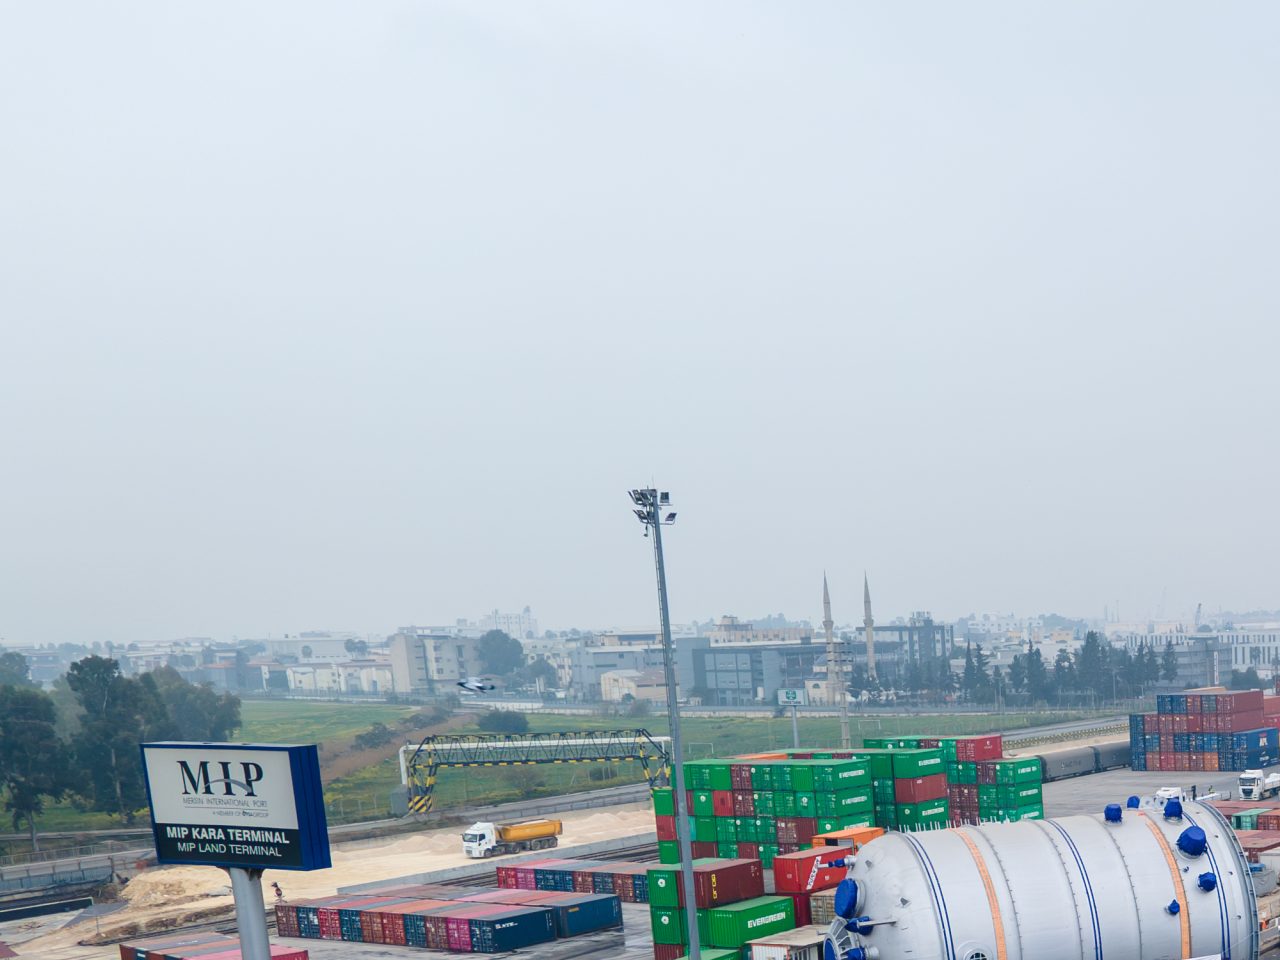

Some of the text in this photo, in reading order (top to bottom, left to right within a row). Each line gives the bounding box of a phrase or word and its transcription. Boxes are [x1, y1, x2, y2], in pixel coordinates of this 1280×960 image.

[176, 760, 264, 797] MIP
[166, 826, 189, 839] MIP
[192, 828, 225, 840] KARA
[178, 842, 282, 857] MIP LAND TERMINAL
[748, 911, 786, 928] EVERGREEN
